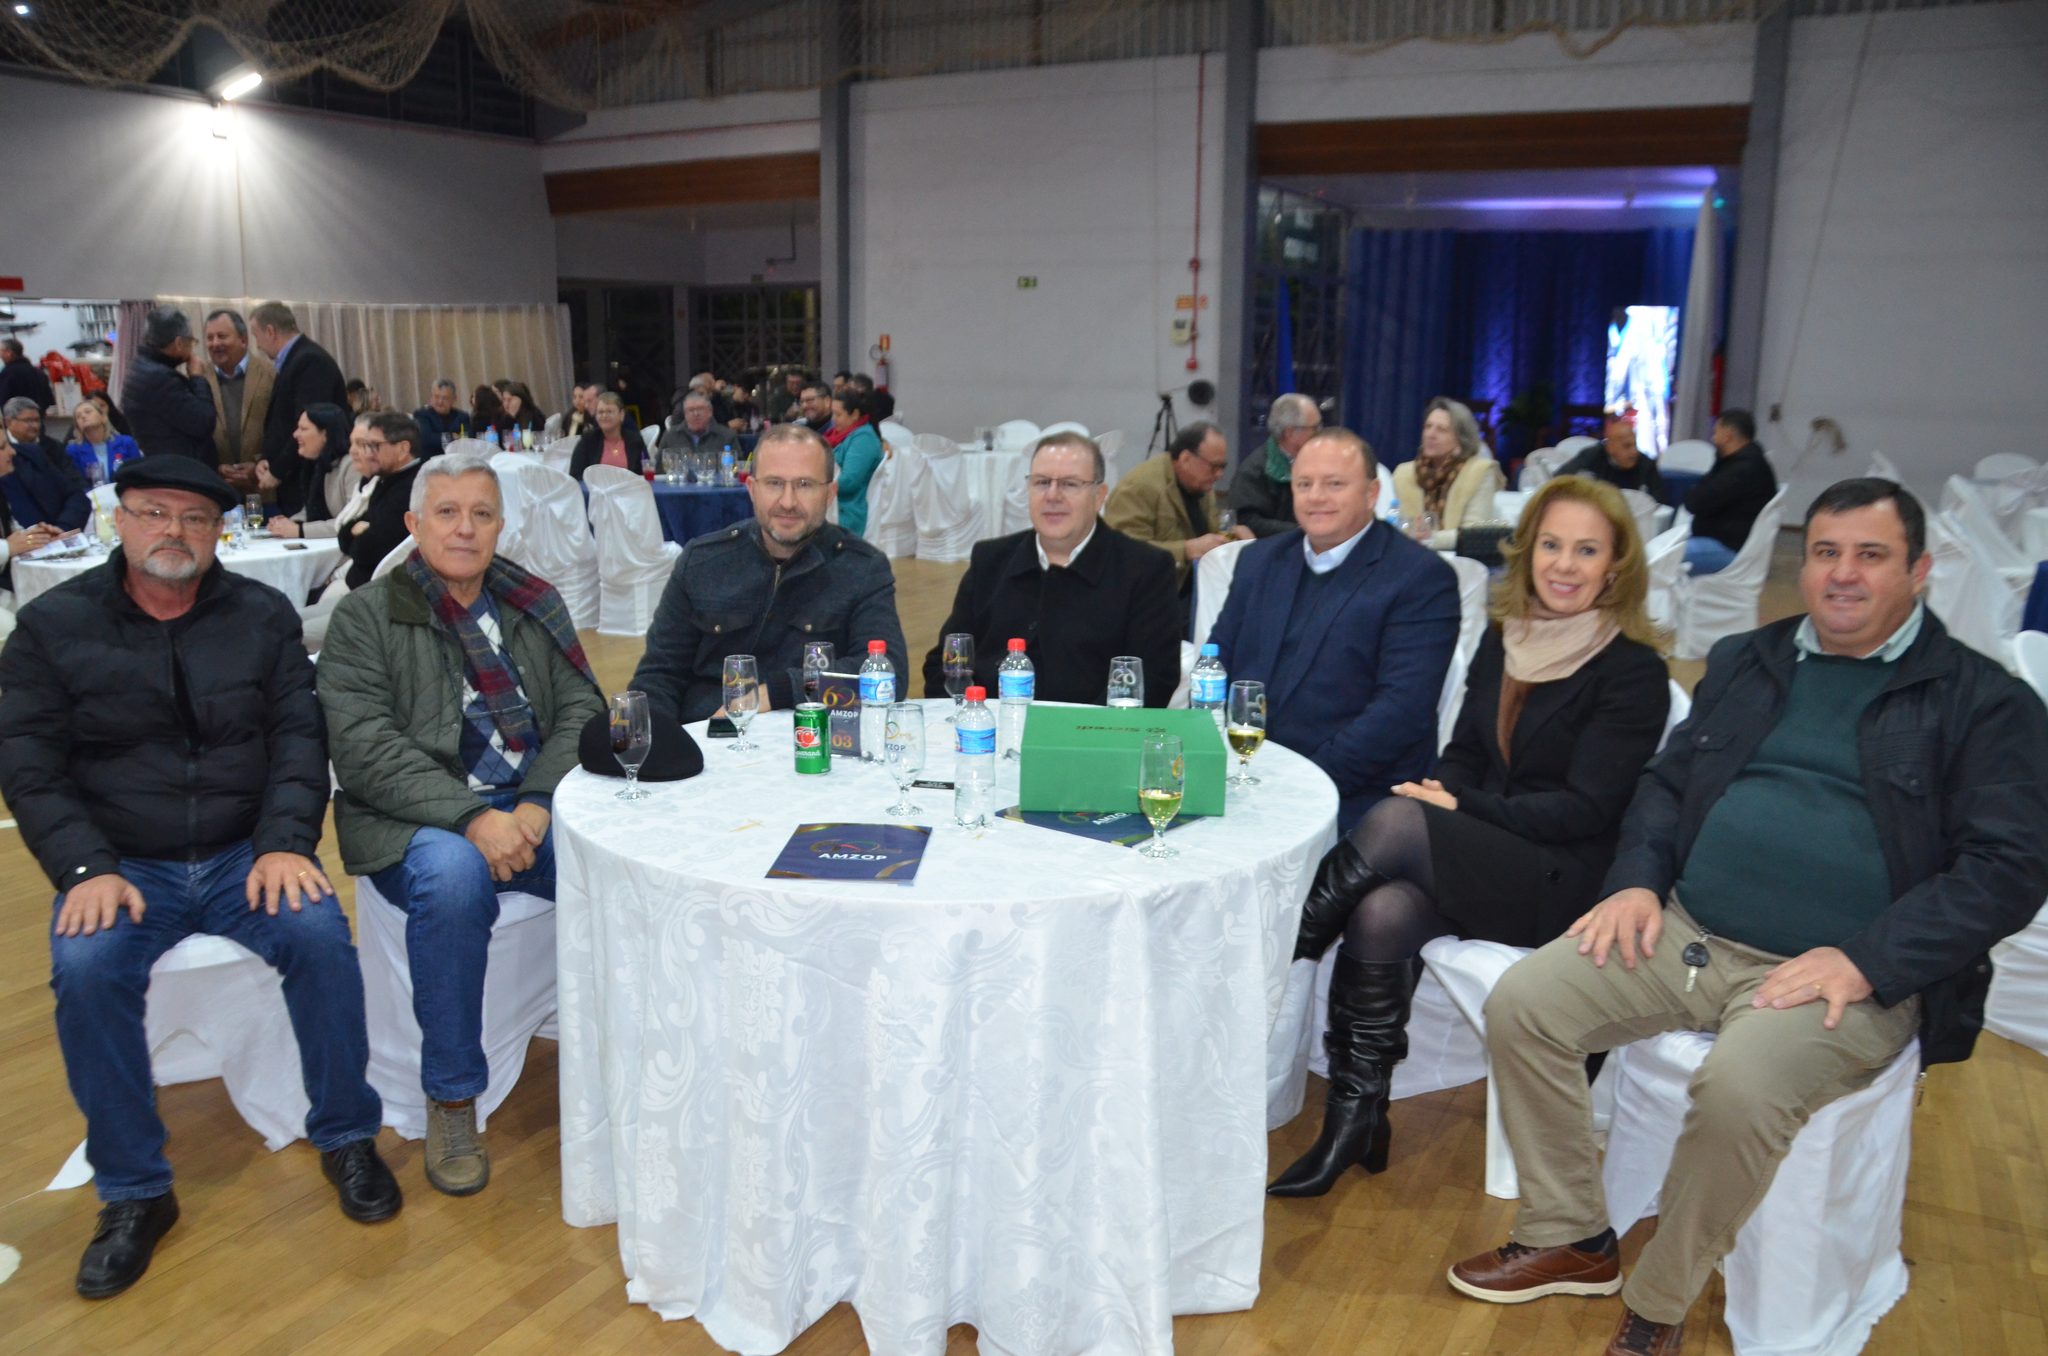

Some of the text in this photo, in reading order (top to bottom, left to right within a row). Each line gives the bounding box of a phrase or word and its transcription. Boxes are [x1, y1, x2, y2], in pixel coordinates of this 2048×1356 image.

[830, 709, 859, 719] AMZOP
[832, 734, 853, 749] 03
[818, 852, 888, 861] AMZOP
